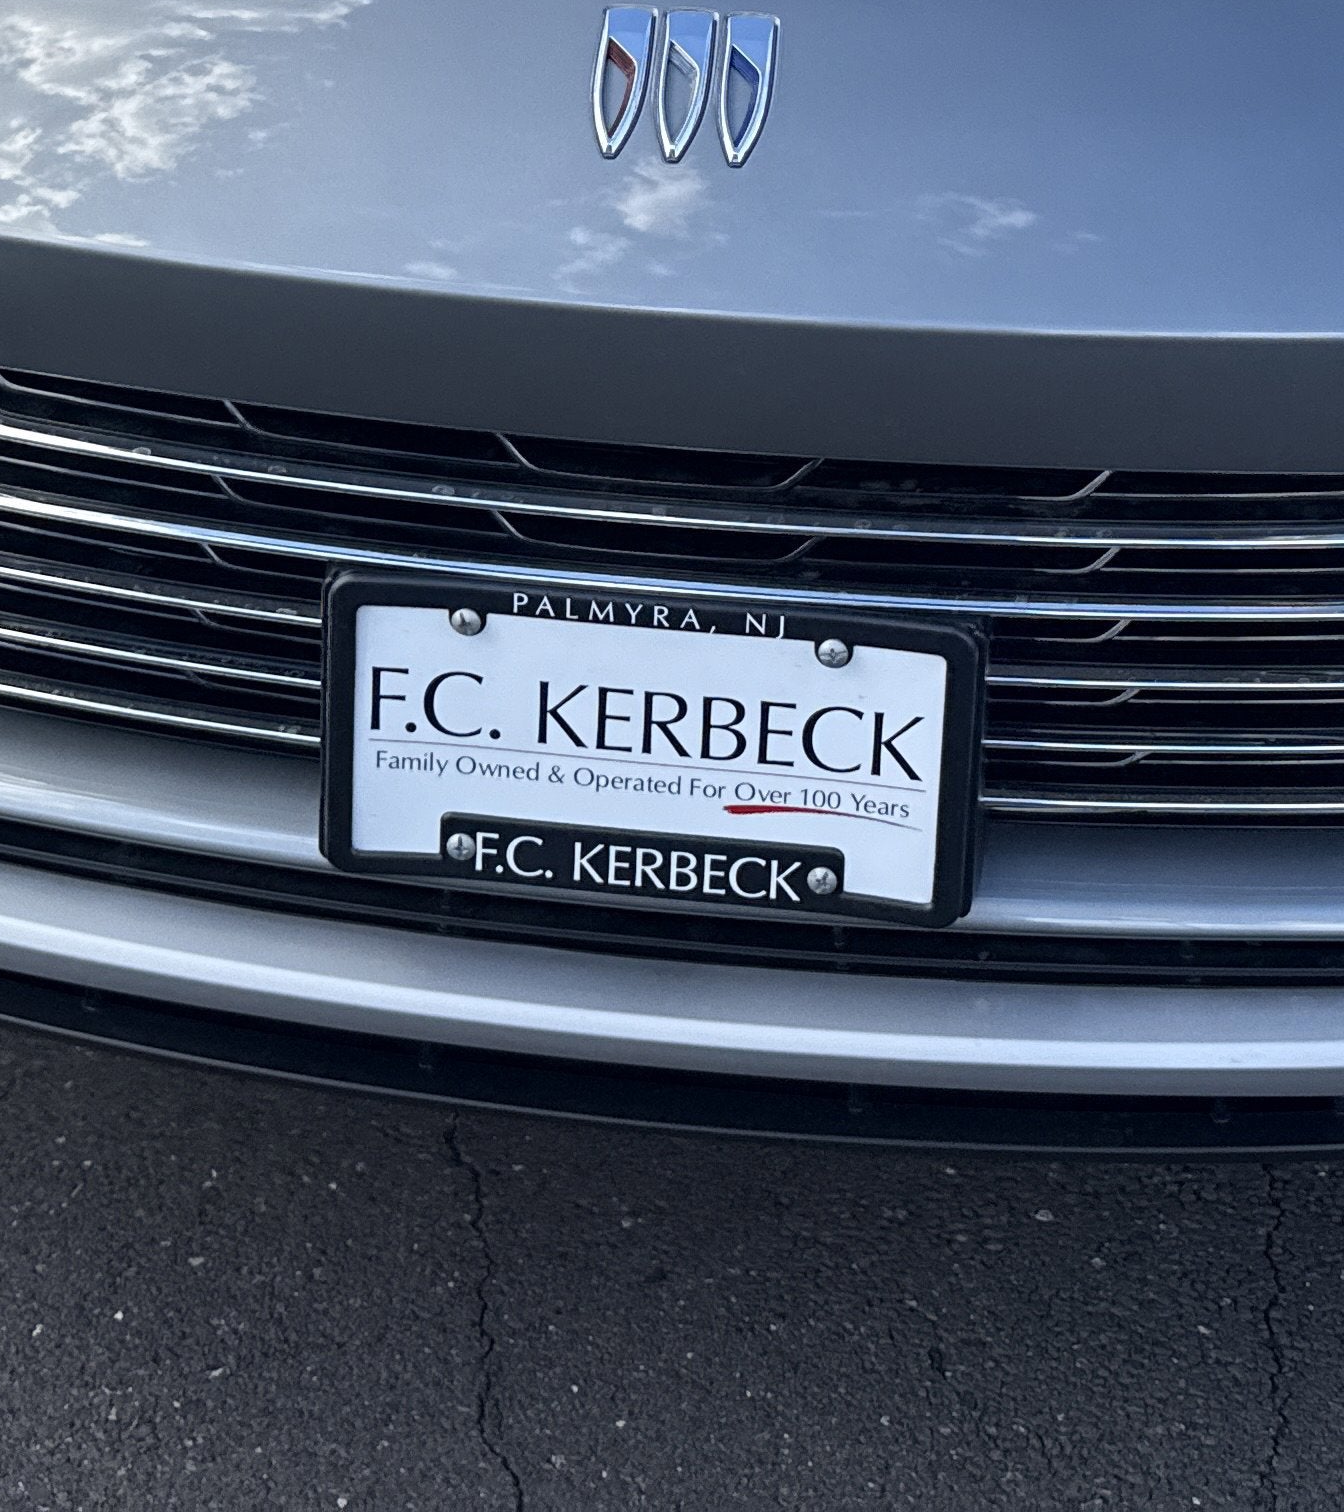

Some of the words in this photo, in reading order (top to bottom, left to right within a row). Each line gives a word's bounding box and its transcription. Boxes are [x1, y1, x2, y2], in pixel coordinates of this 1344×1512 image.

[512, 592, 716, 634] PALMYRA,
[745, 612, 786, 639] NJ
[370, 666, 501, 740] F.C.
[537, 680, 925, 782] KERBECK
[375, 749, 448, 777] Family
[455, 755, 540, 781] Owned
[547, 765, 566, 784] &
[573, 767, 682, 795] Operated
[689, 778, 726, 799] For
[734, 782, 792, 805] Over
[800, 789, 841, 810] 100
[850, 792, 910, 819] Years
[474, 831, 554, 880] F.C.
[573, 841, 802, 902] KERBECK
